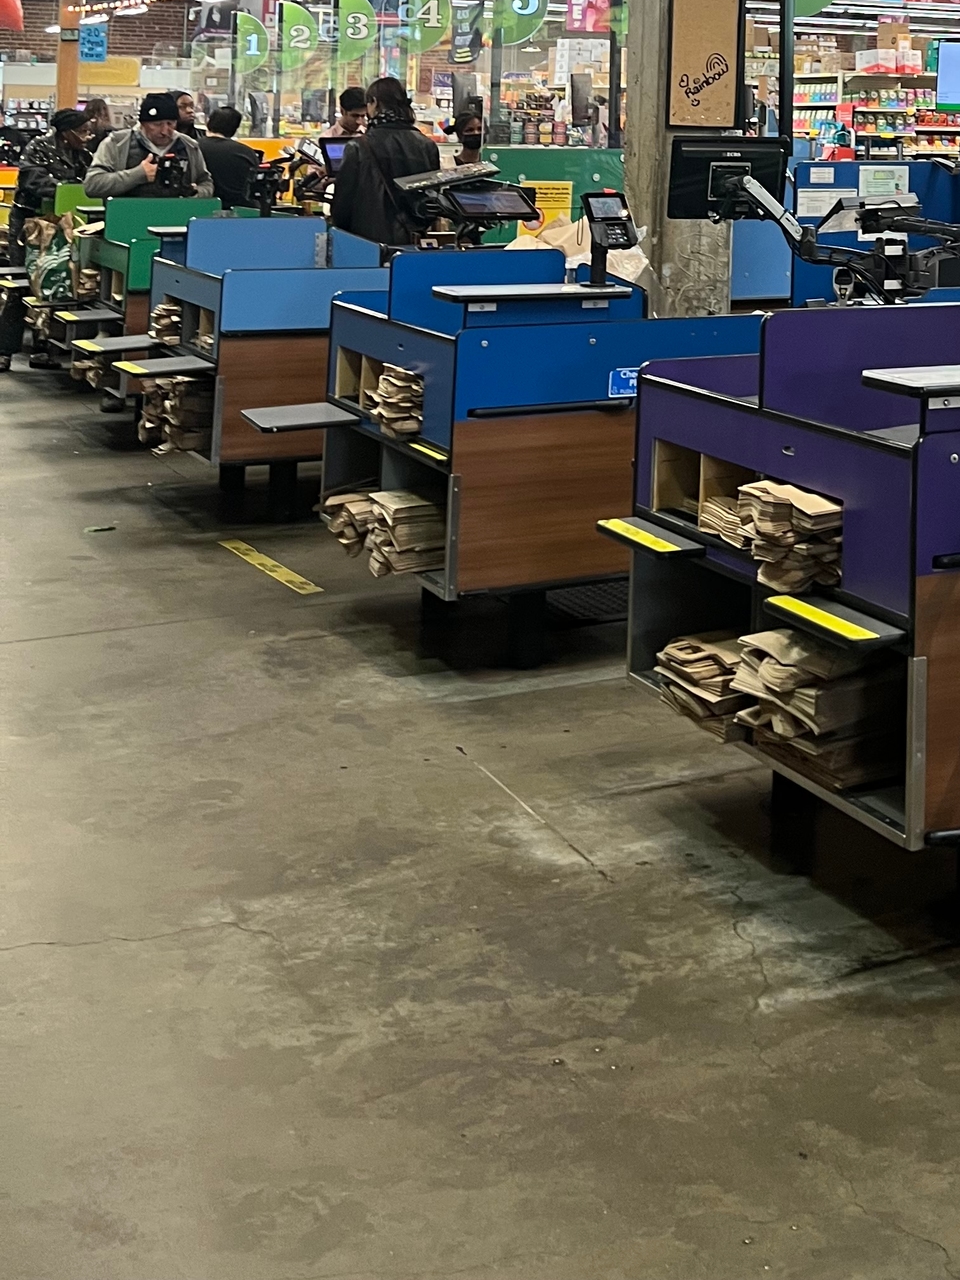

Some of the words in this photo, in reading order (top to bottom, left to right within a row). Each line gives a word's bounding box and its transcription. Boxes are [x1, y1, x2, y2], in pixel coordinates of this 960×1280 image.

[86, 28, 100, 37] 20
[289, 25, 311, 49] 2
[345, 12, 369, 40] 3
[246, 33, 261, 55] 1
[685, 63, 729, 98] Rainbow
